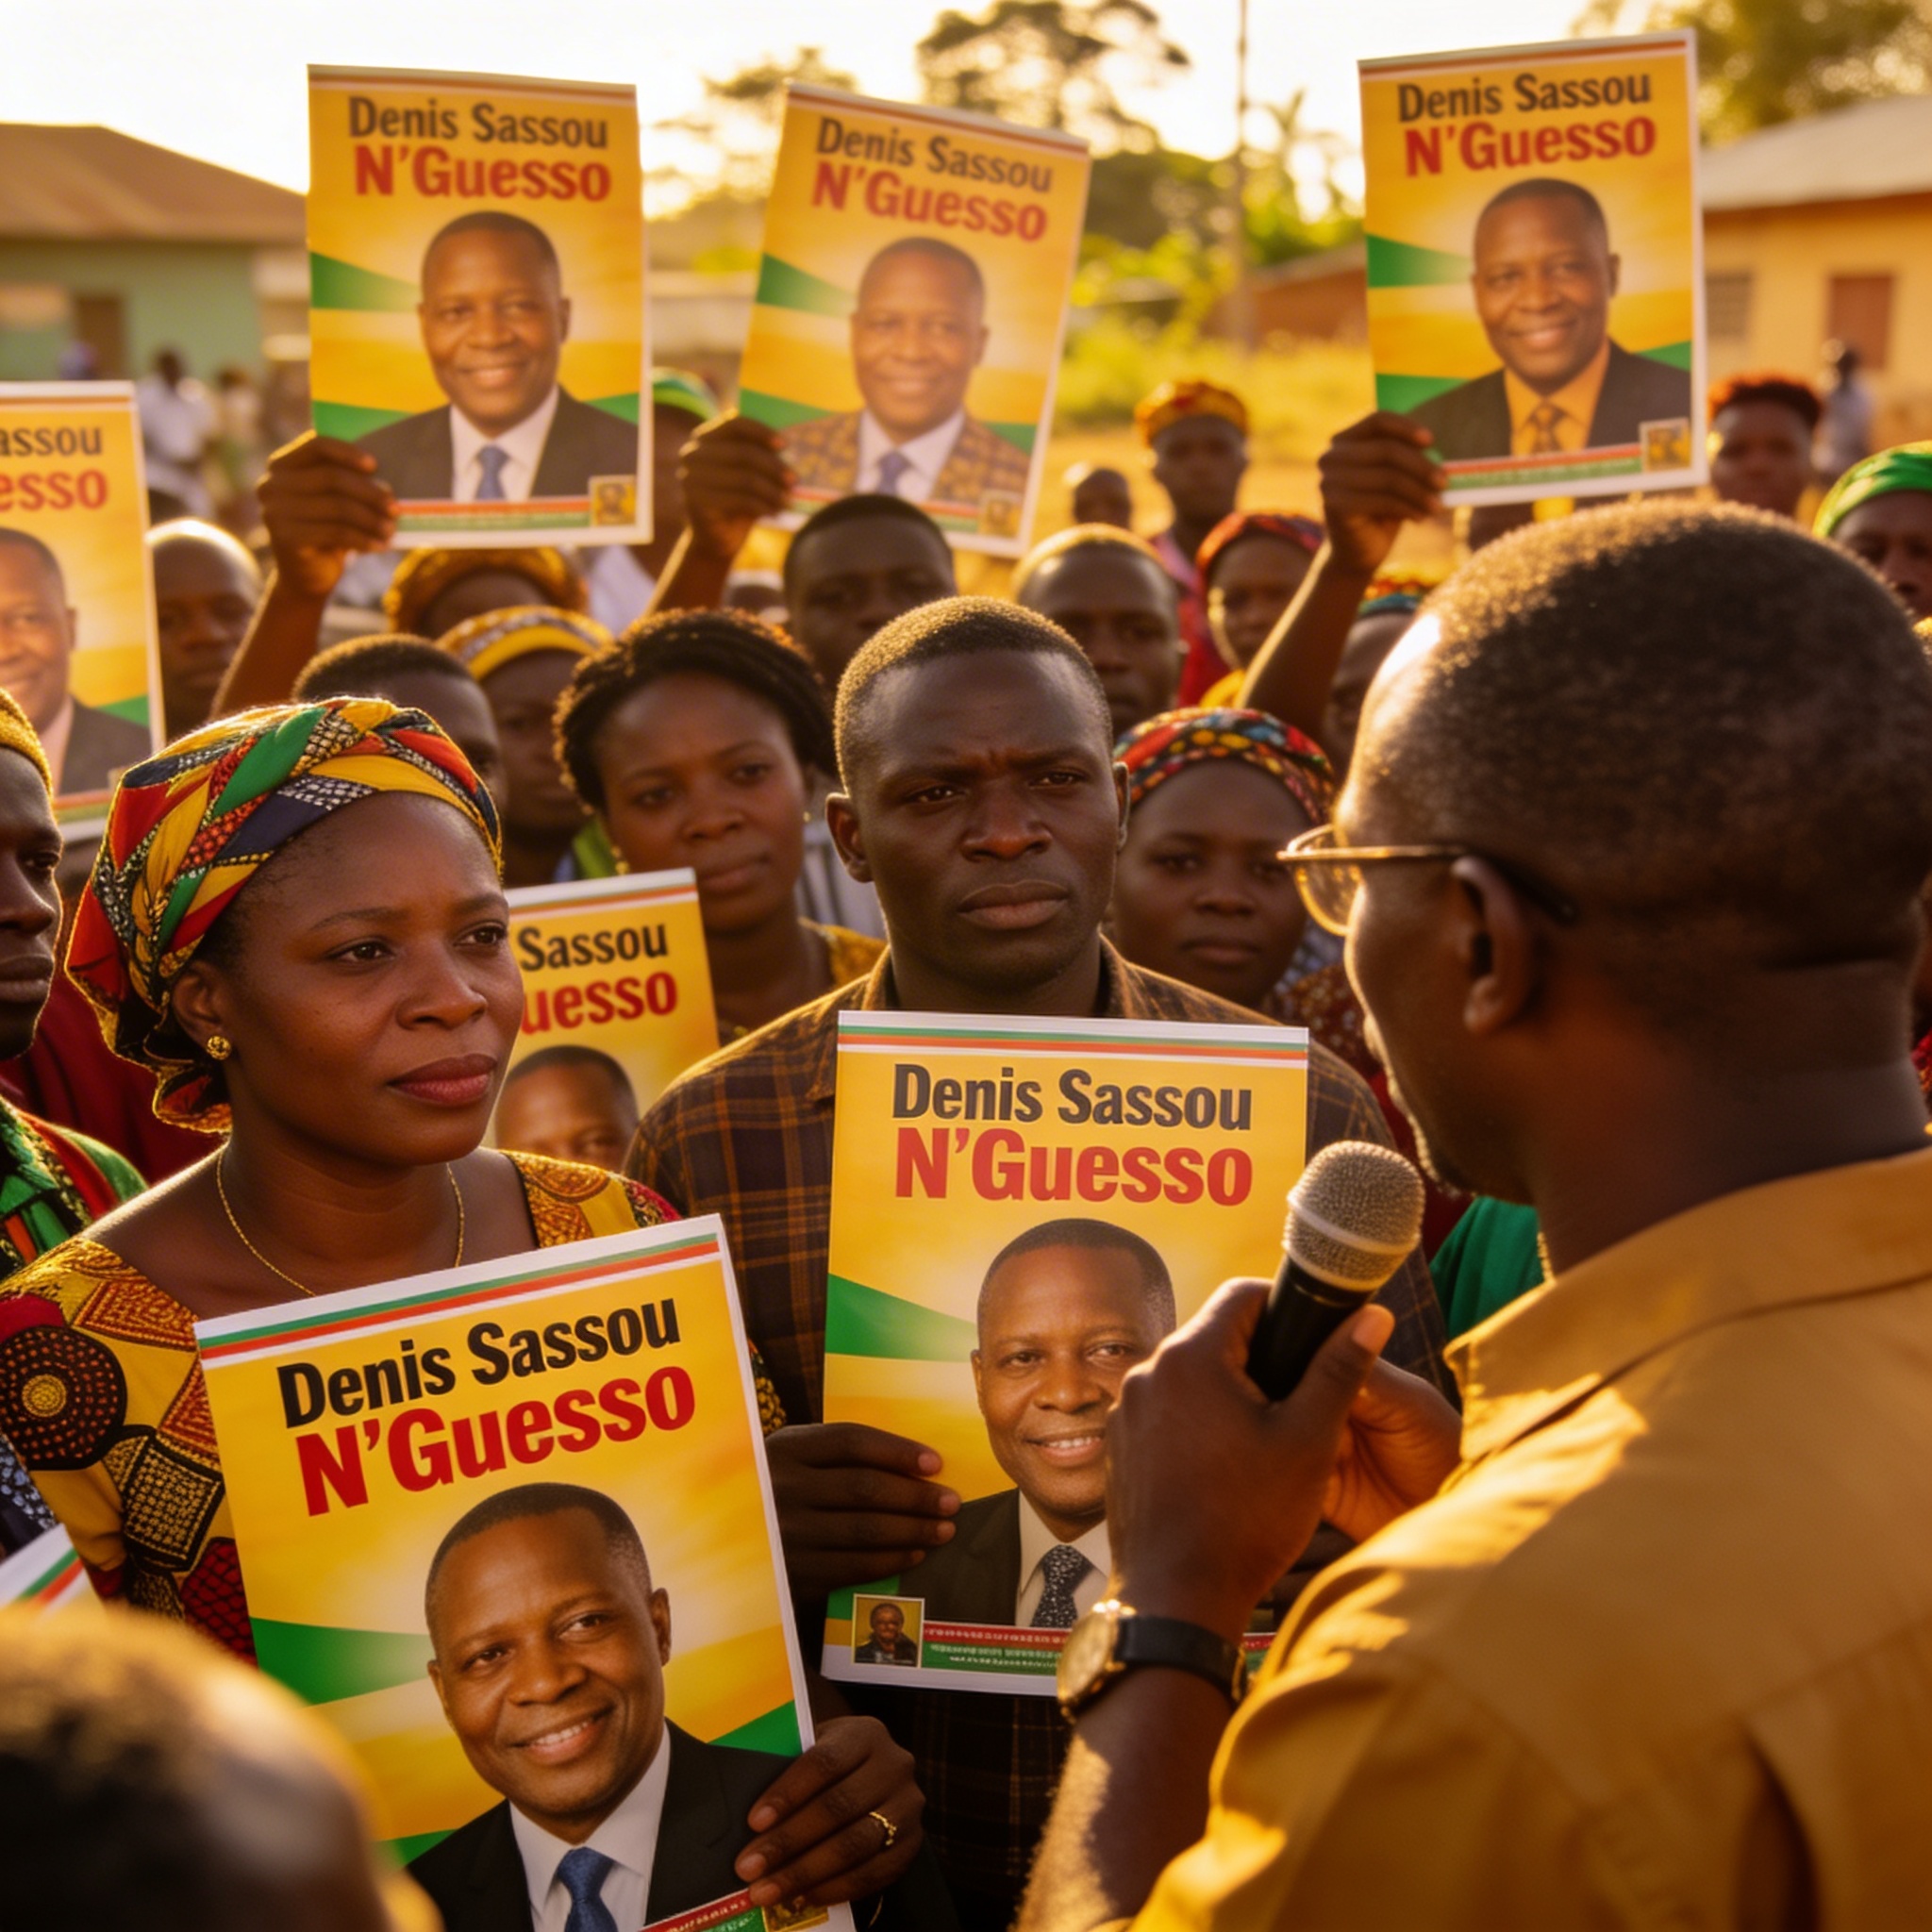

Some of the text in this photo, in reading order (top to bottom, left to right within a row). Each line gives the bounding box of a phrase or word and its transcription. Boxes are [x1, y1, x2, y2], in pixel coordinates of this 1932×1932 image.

[348, 95, 608, 149] Denis Sassou
[1397, 72, 1652, 123] Denis Sassou
[354, 143, 612, 202] N'Guesso
[816, 116, 1053, 192] Denis Sassou
[1404, 116, 1657, 177] N'Guesso
[810, 158, 1048, 242] N'Guesso
[0, 426, 103, 458] assou
[517, 924, 669, 972] Sassou
[521, 971, 678, 1036] uesso
[892, 1063, 1252, 1131] Denis Sassou
[895, 1127, 1253, 1207] N'Guesso
[276, 1298, 681, 1429] Denis Sassou
[295, 1366, 695, 1517] N'Guesso
